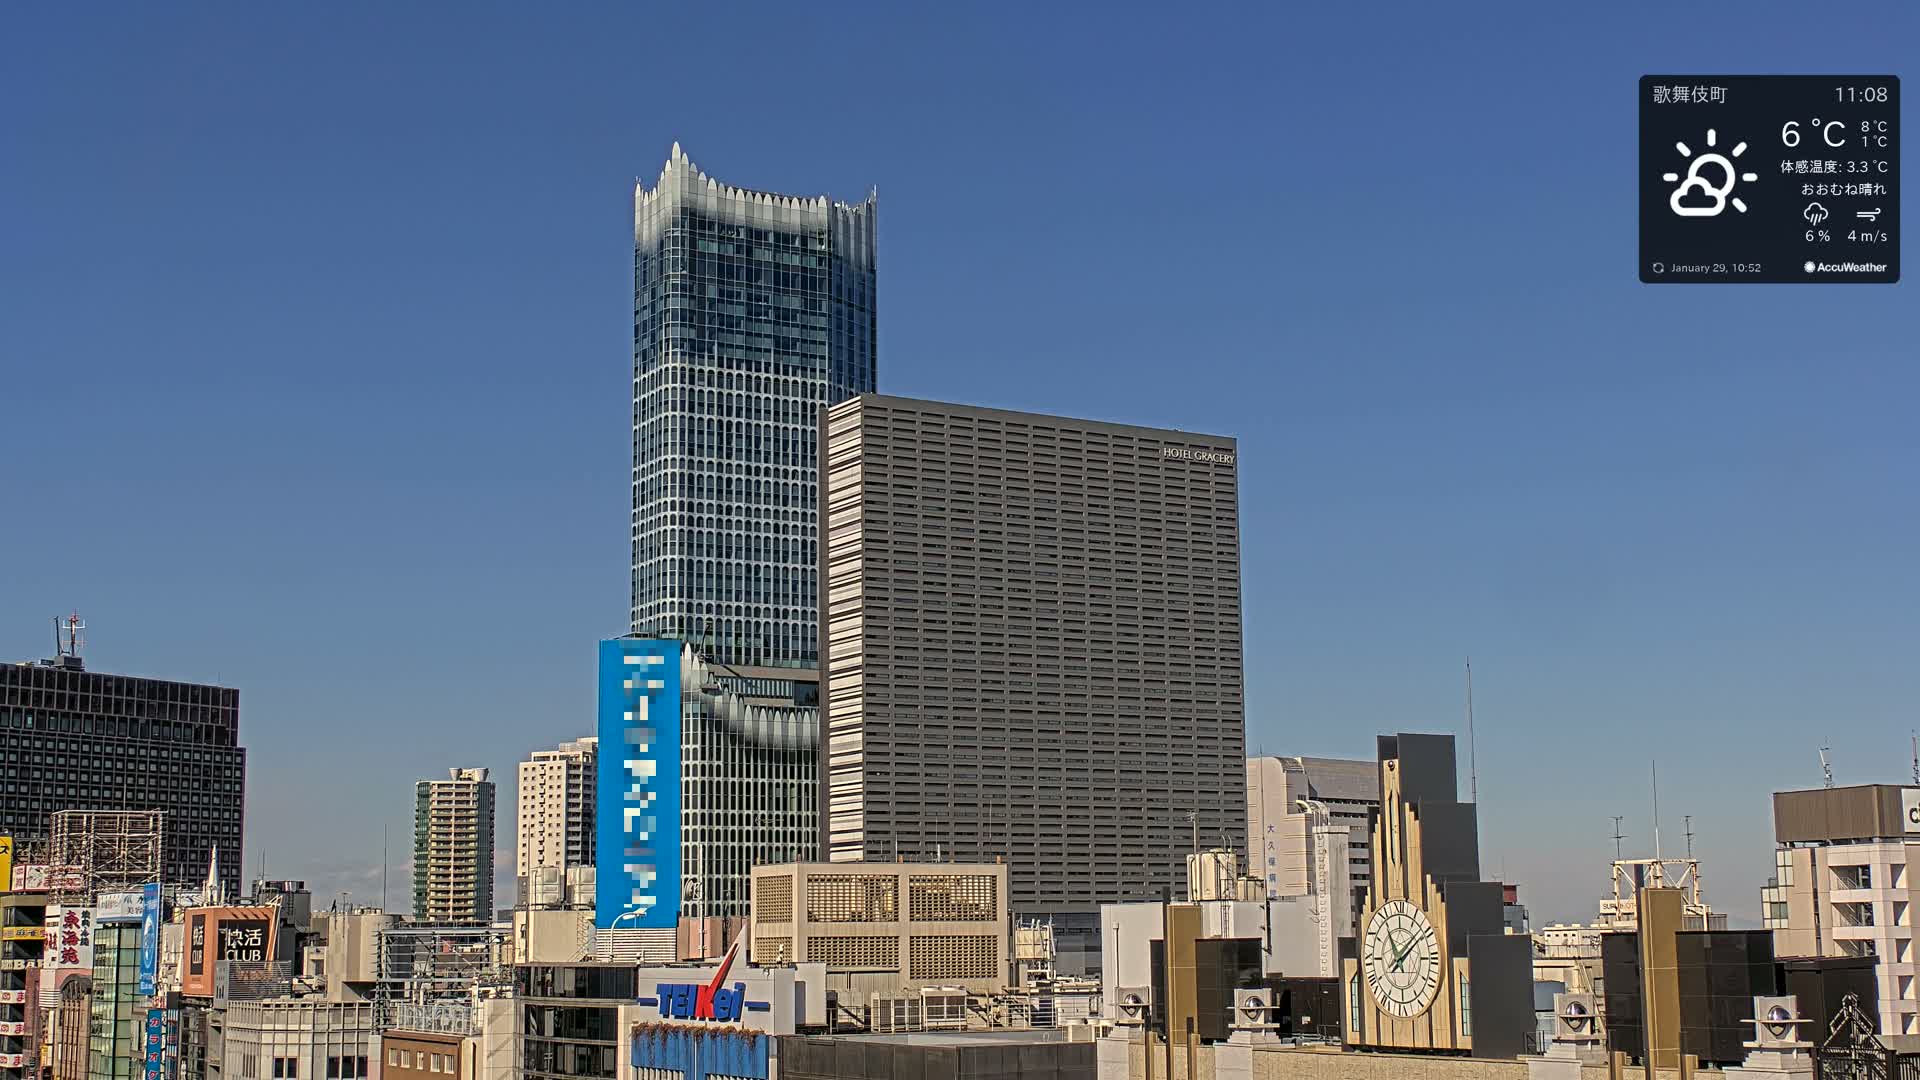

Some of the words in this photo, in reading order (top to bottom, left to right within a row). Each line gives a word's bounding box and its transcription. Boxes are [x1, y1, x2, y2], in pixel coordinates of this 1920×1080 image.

[1164, 448, 1192, 459] HOTEL
[1194, 451, 1234, 464] GRACERY
[60, 910, 81, 965] 東海苑
[228, 928, 262, 947] 快活
[226, 949, 262, 962] CLUB
